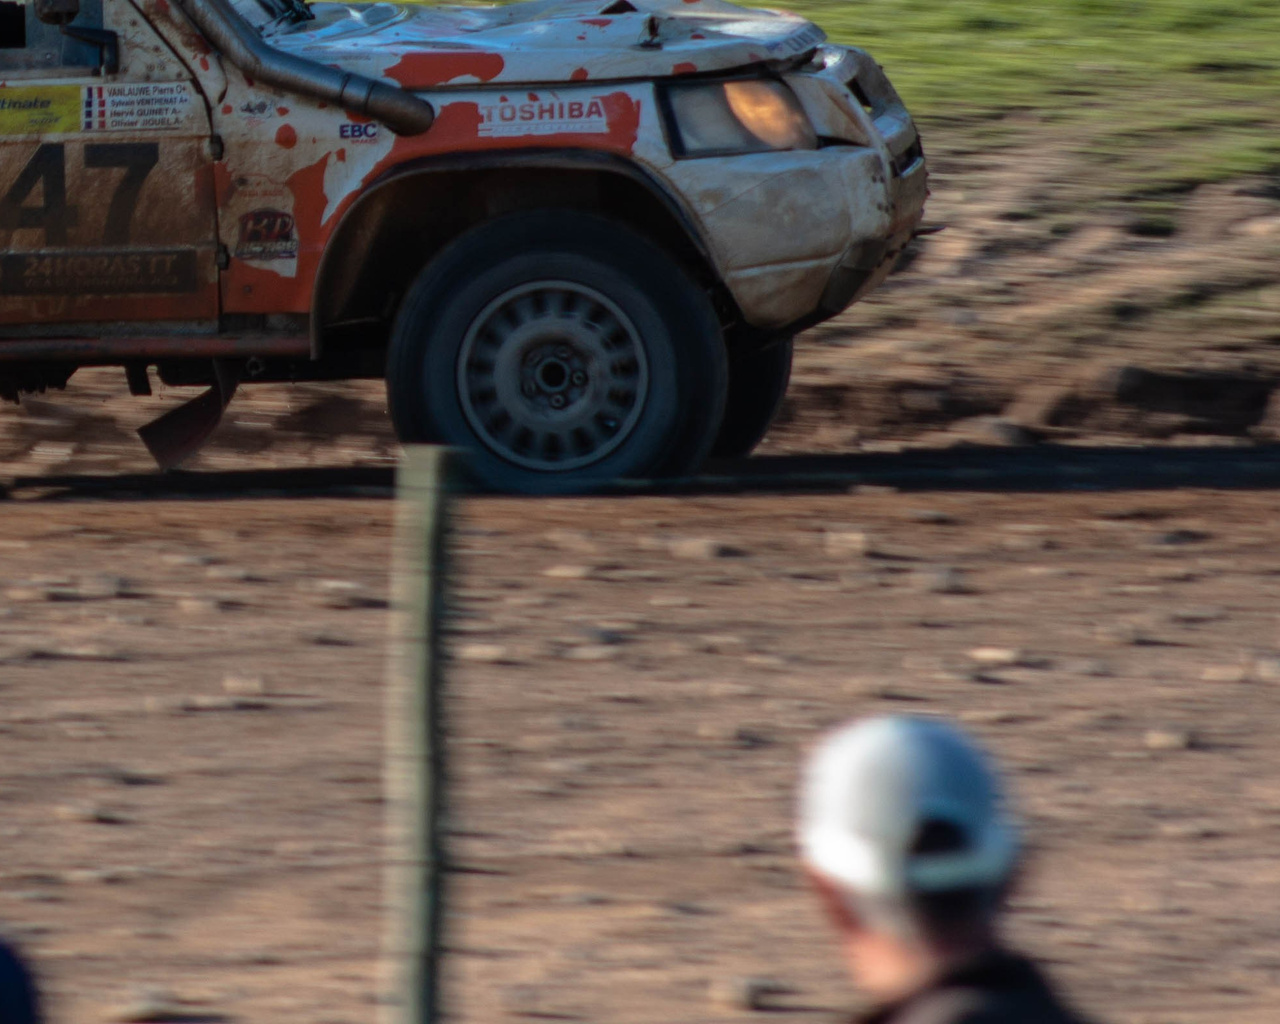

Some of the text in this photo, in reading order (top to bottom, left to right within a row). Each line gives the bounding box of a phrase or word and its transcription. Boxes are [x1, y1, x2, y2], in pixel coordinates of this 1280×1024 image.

[107, 86, 150, 97] VANLAUWE
[152, 86, 174, 96] Pierre
[481, 101, 602, 122] TOSHIBA
[340, 123, 377, 138] EBC
